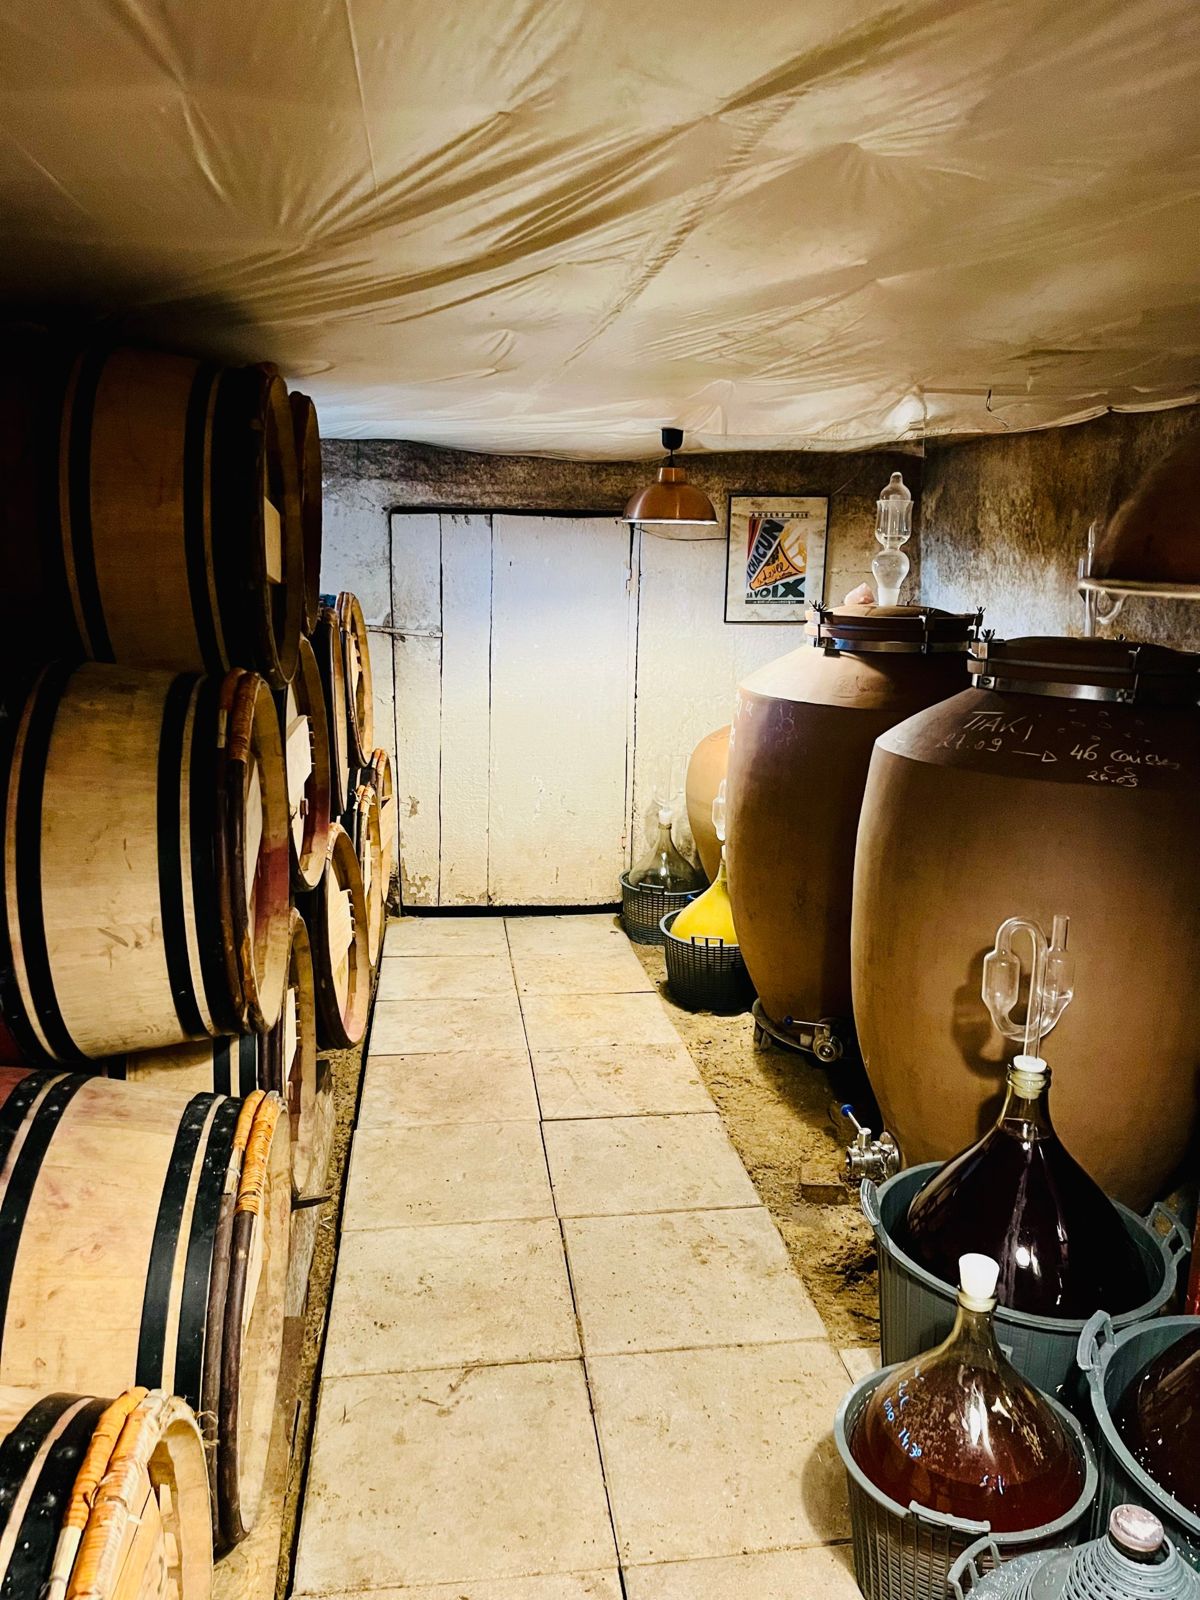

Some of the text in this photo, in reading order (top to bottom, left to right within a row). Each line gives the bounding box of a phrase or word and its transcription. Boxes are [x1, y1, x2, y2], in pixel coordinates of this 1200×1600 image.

[748, 519, 785, 573] CHACUN
[754, 577, 805, 598] VOIX
[1069, 743, 1100, 760] 46
